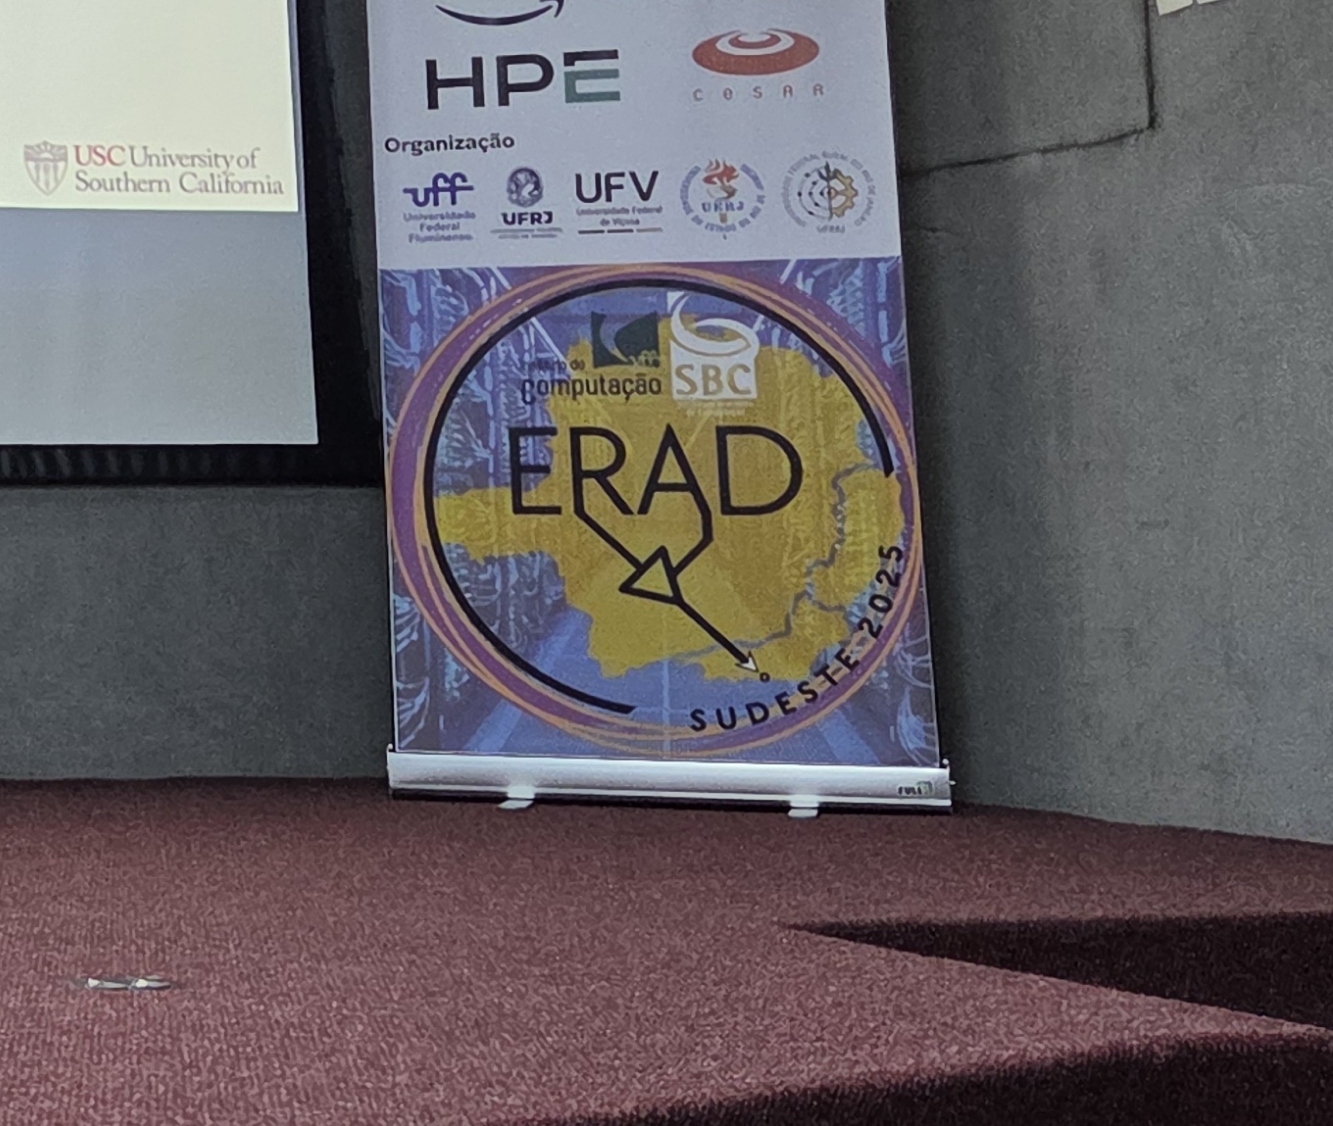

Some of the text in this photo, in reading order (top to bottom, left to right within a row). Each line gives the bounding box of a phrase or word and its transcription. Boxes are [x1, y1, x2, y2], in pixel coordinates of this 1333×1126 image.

[425, 48, 621, 110] HPE
[74, 145, 261, 172] USC University of
[384, 131, 515, 156] Organização
[75, 170, 284, 195] Southern California
[402, 172, 474, 207] uff
[575, 170, 659, 203] UFV
[501, 211, 553, 225] UFRJ
[675, 363, 752, 396] SBC
[508, 423, 804, 517] ERAD
[689, 544, 904, 733] SUDESTE 2025
